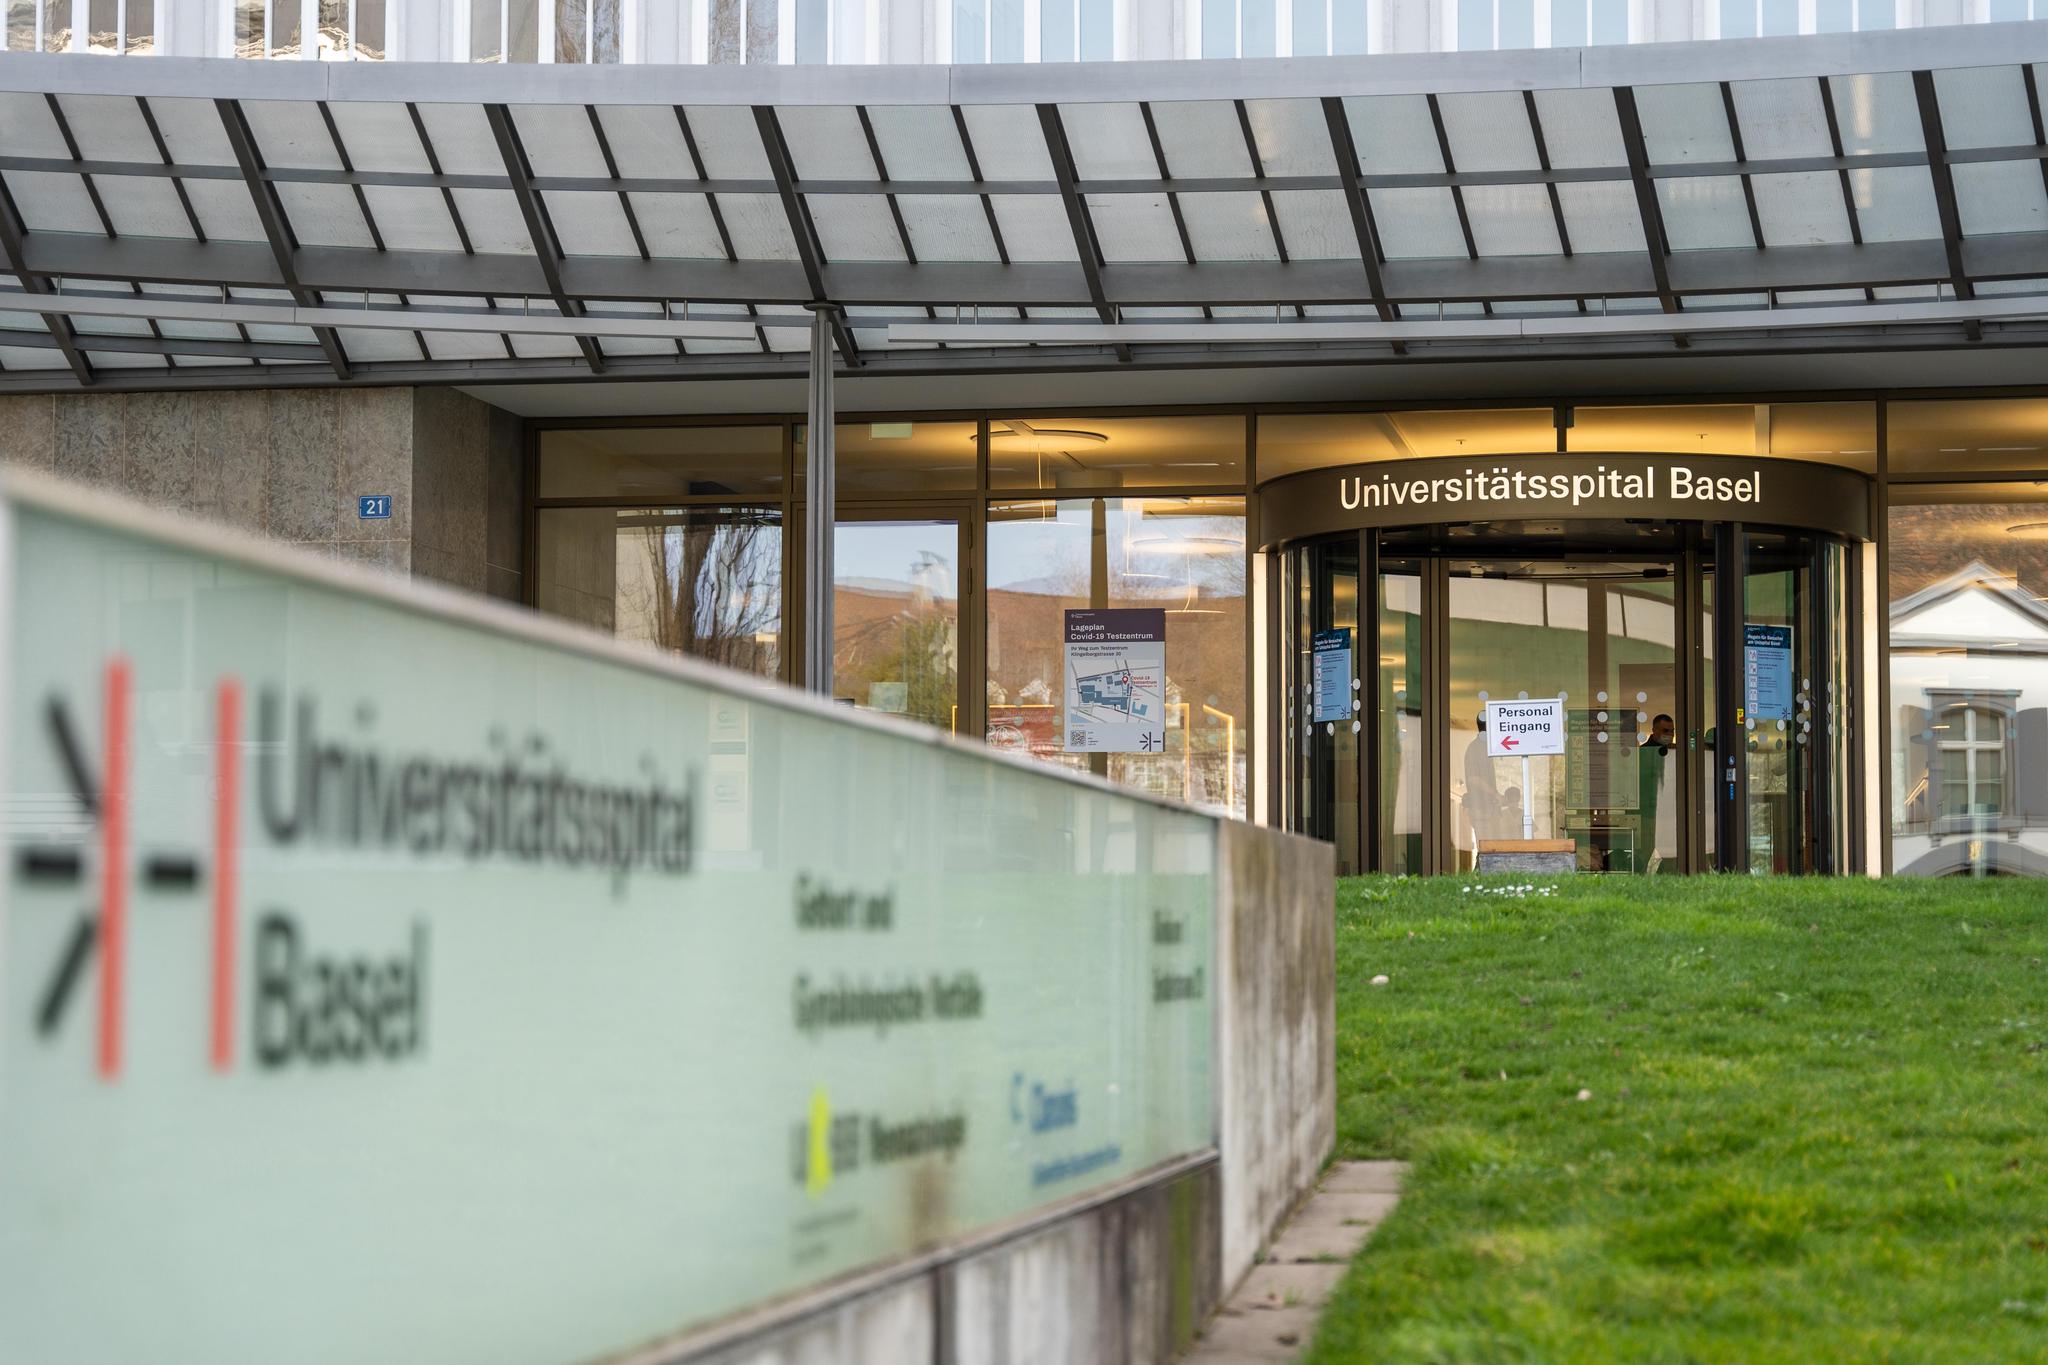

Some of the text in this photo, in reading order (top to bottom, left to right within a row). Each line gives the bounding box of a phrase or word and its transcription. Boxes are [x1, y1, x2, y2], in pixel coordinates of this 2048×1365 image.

[1341, 466, 1760, 510] Universitätsspital Basel
[366, 499, 383, 514] 21
[1070, 624, 1105, 632] Lageplan
[1107, 632, 1154, 640] Testzentrum
[1498, 706, 1553, 717] Personal
[1500, 722, 1551, 733] Eingang
[256, 687, 698, 904] Universitätsspital
[254, 911, 431, 1068] Basel
